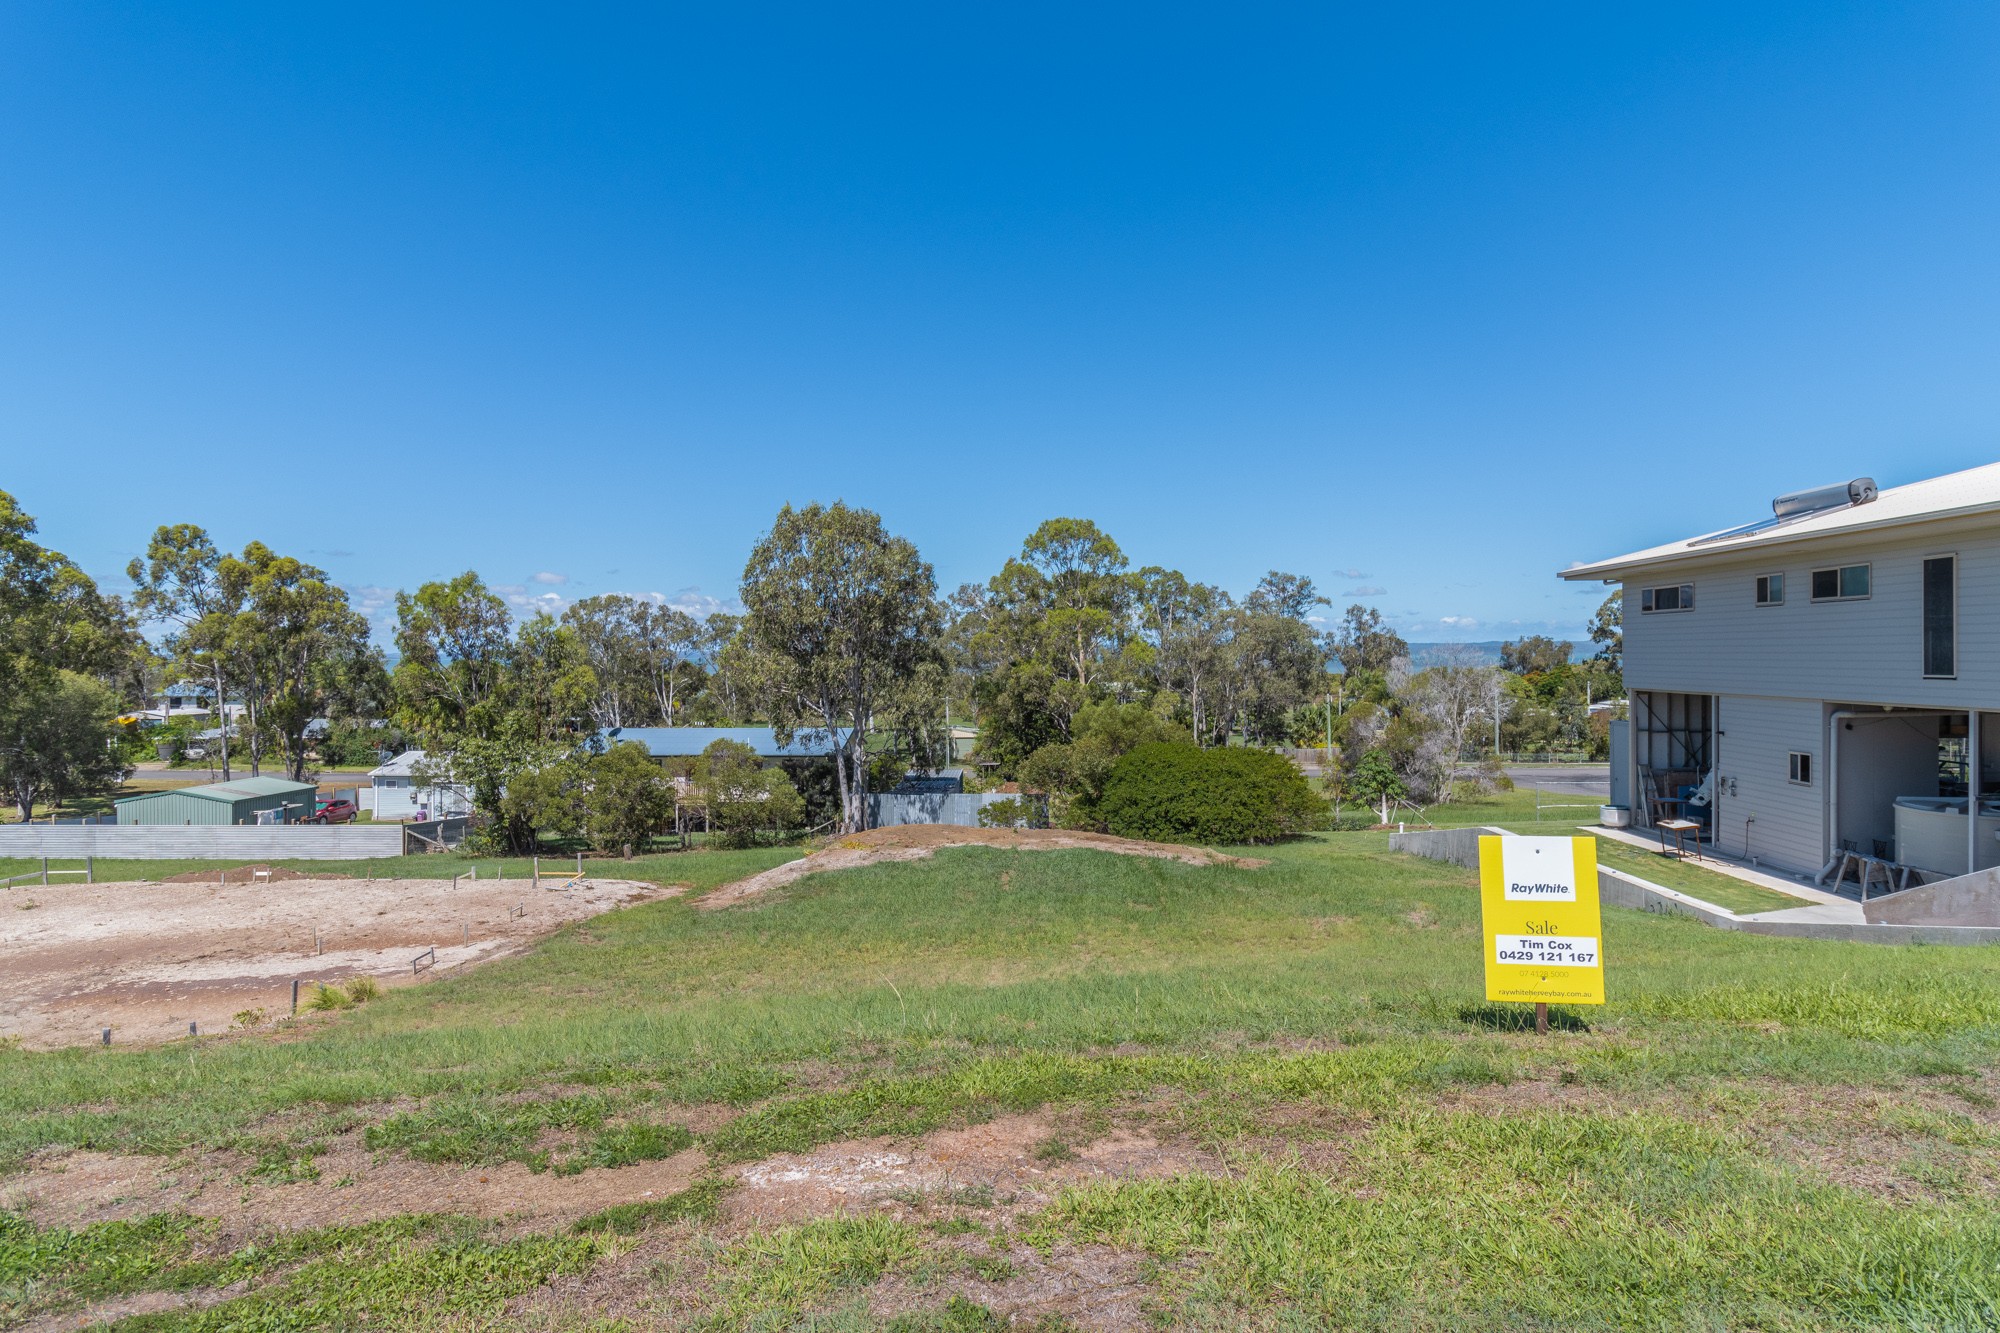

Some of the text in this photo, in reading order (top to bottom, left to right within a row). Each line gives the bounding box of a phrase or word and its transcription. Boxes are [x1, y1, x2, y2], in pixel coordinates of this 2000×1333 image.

[1525, 920, 1558, 935] Sale
[1520, 939, 1573, 950] Tim Cox
[1499, 950, 1594, 963] 0429 121 167
[1498, 989, 1592, 998] raywhiteherveybay.com.au
